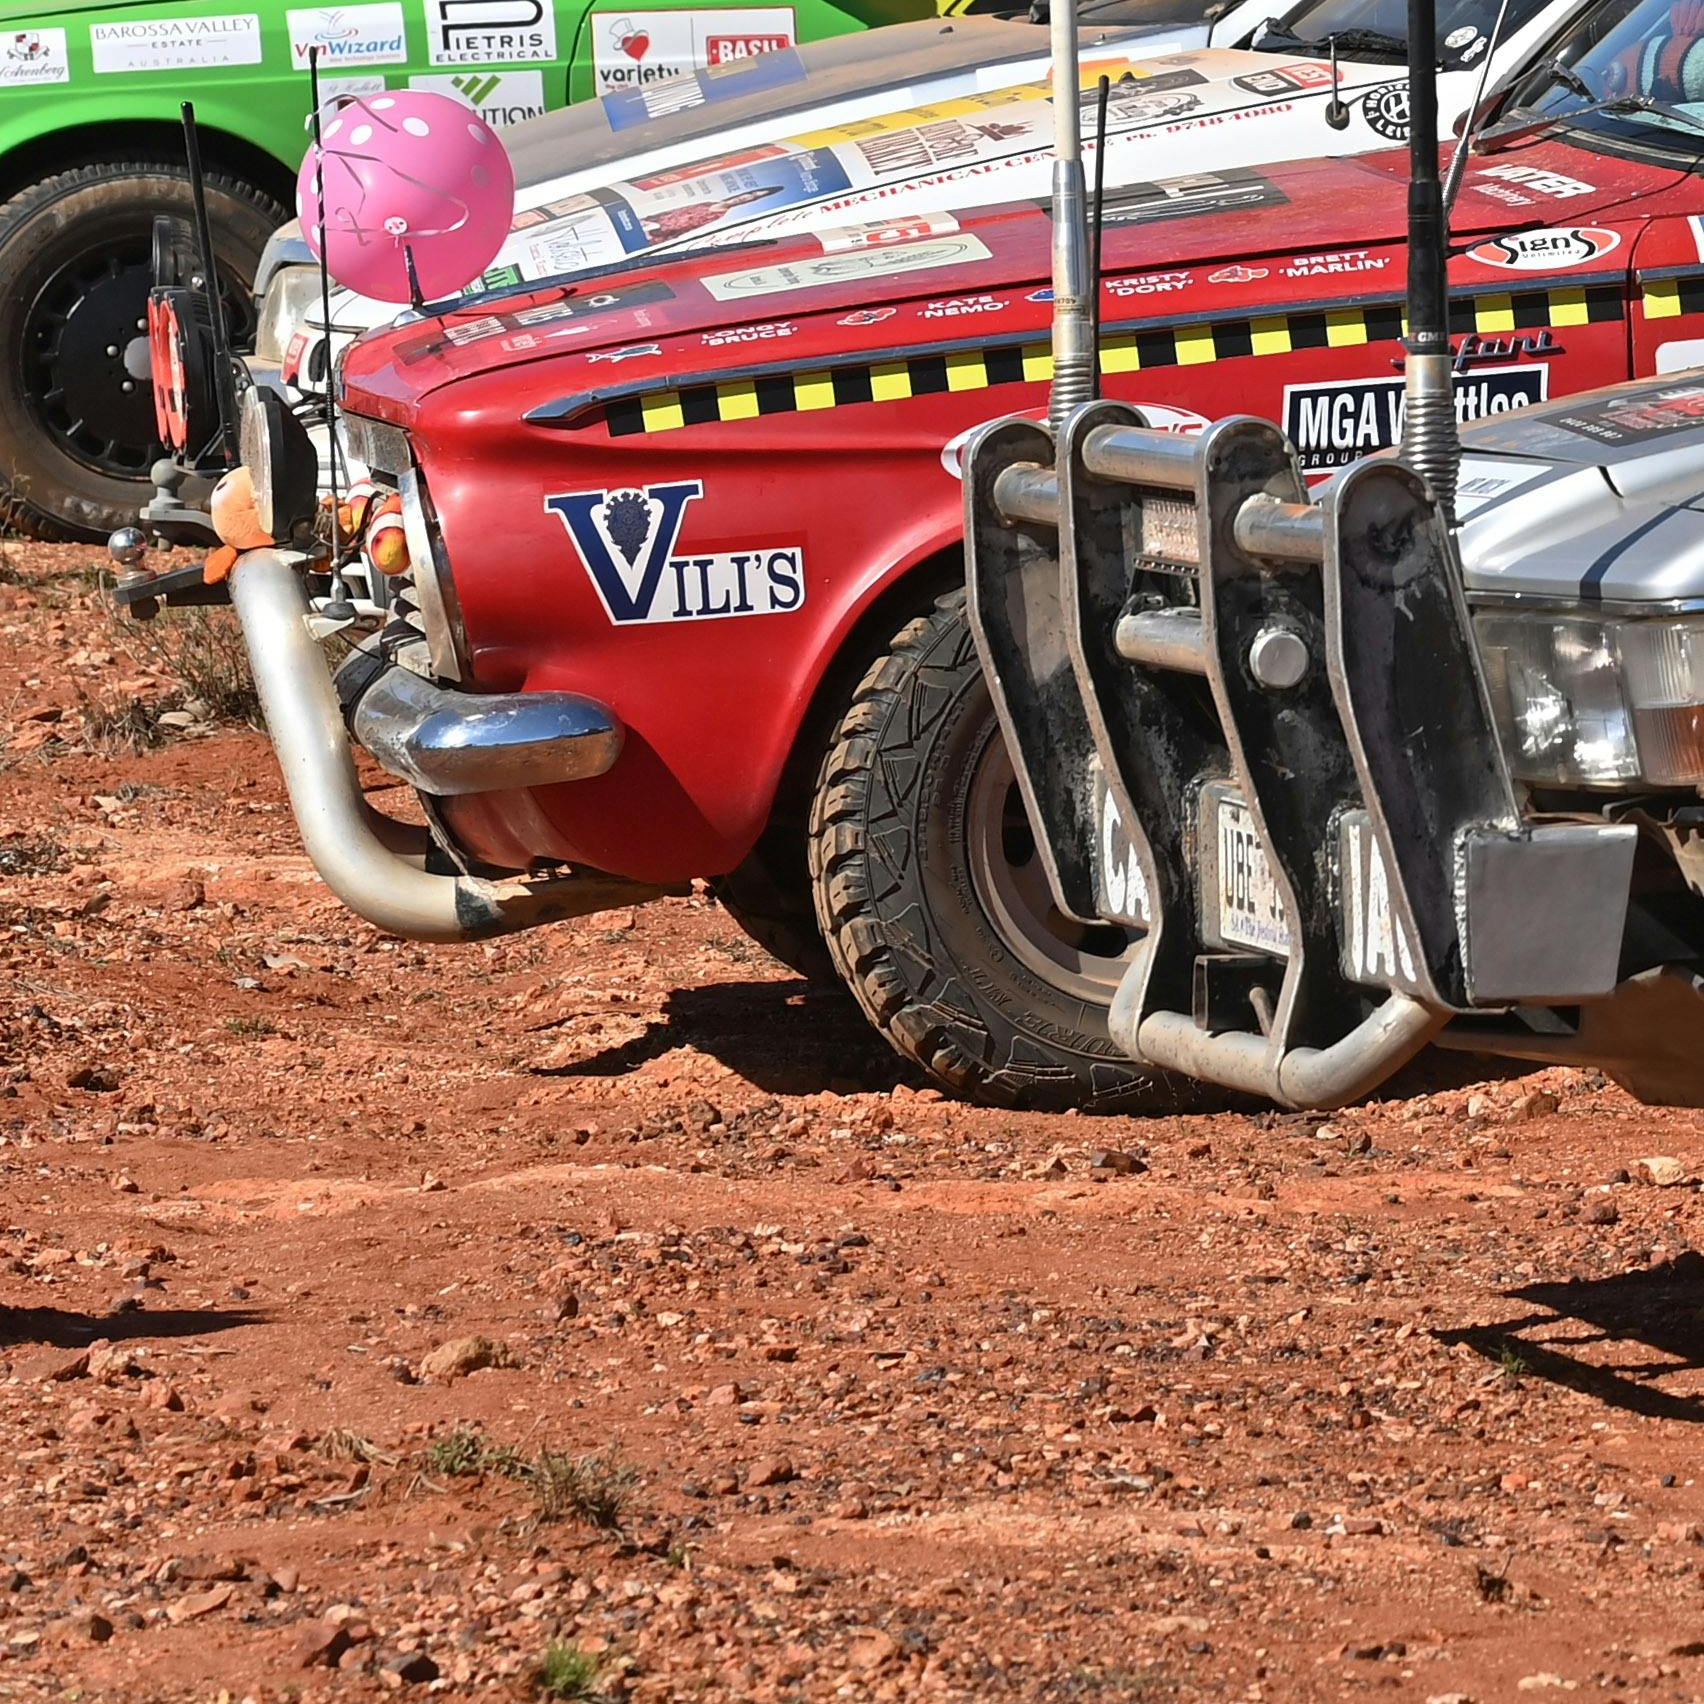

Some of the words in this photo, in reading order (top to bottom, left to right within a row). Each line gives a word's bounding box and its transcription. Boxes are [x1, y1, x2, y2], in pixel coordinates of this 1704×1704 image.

[96, 20, 181, 41] BAROSSA
[186, 17, 254, 35] VALLEY
[151, 39, 203, 49] ESTATE
[128, 54, 230, 68] AUSTRALIA
[436, 49, 553, 63] ELECTRICAL
[819, 164, 1001, 215] MECHANICAL
[1484, 162, 1597, 200] VATER
[1278, 256, 1392, 278] 'MARLIN'
[1294, 252, 1369, 267] BRETT
[1104, 272, 1192, 289] KRISTY
[1107, 279, 1195, 296] 'DORY'
[916, 299, 1010, 320] 'NEMO'
[928, 294, 996, 310] KATE
[1298, 390, 1380, 450] MGA
[547, 483, 802, 622] VILI'S
